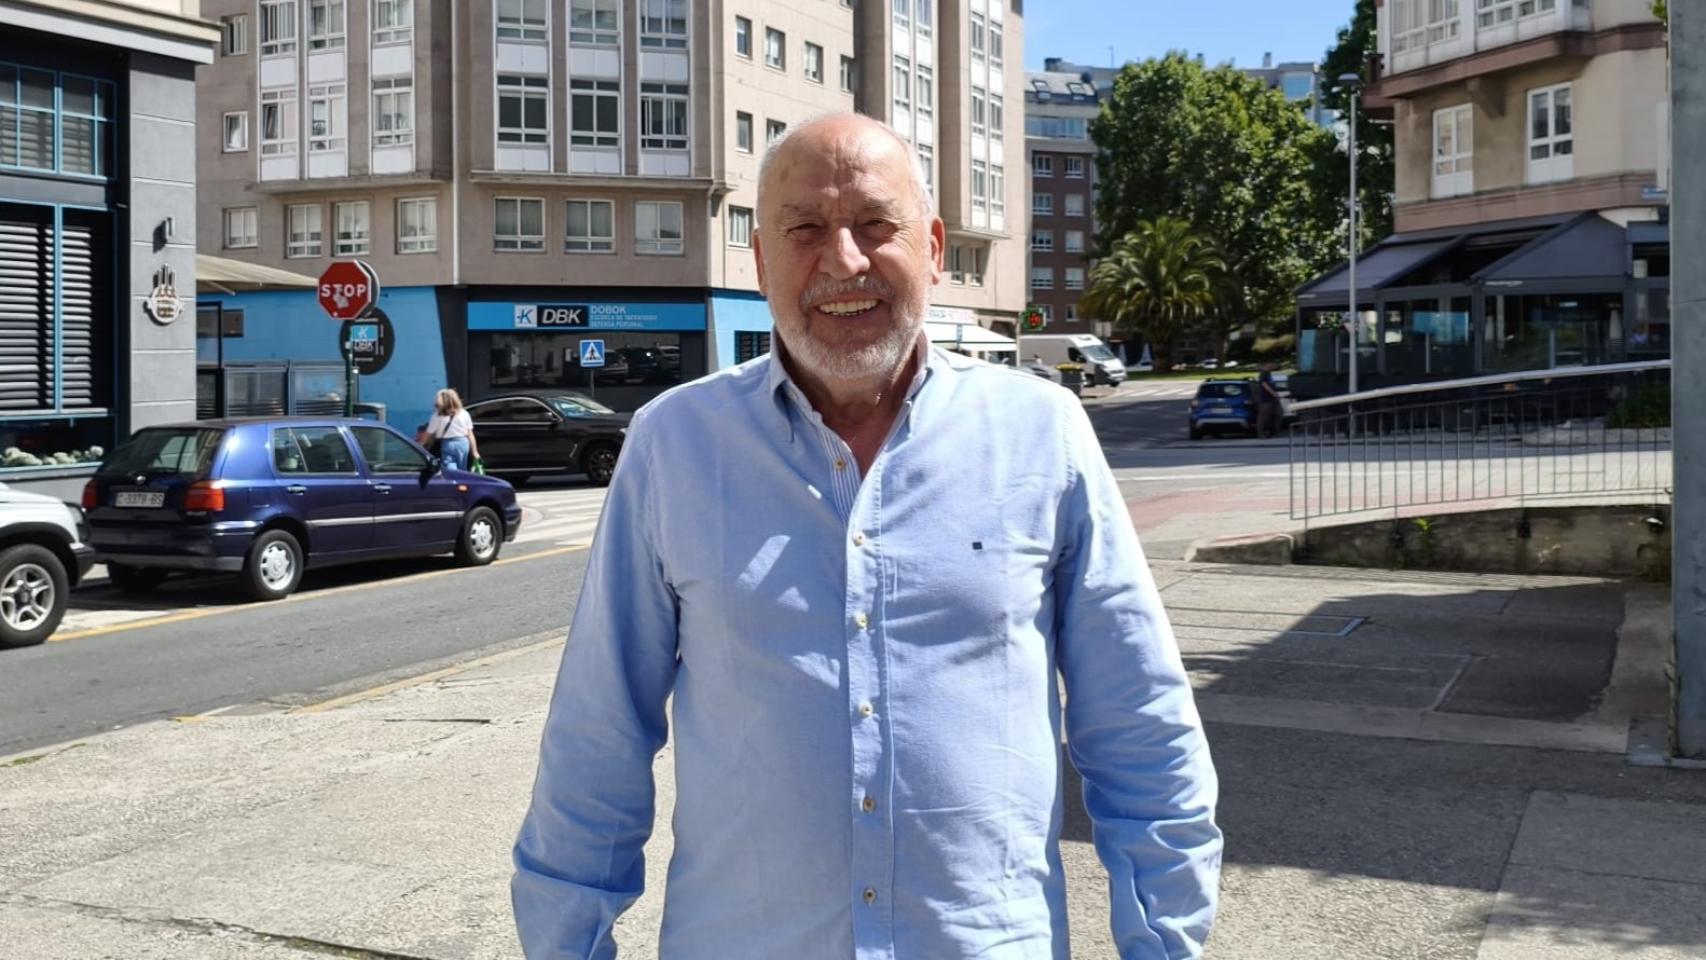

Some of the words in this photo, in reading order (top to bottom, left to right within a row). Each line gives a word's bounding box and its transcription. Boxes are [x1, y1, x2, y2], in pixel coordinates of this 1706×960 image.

[320, 283, 367, 298] STOP
[542, 308, 582, 324] DBK
[590, 305, 627, 314] DOBOK
